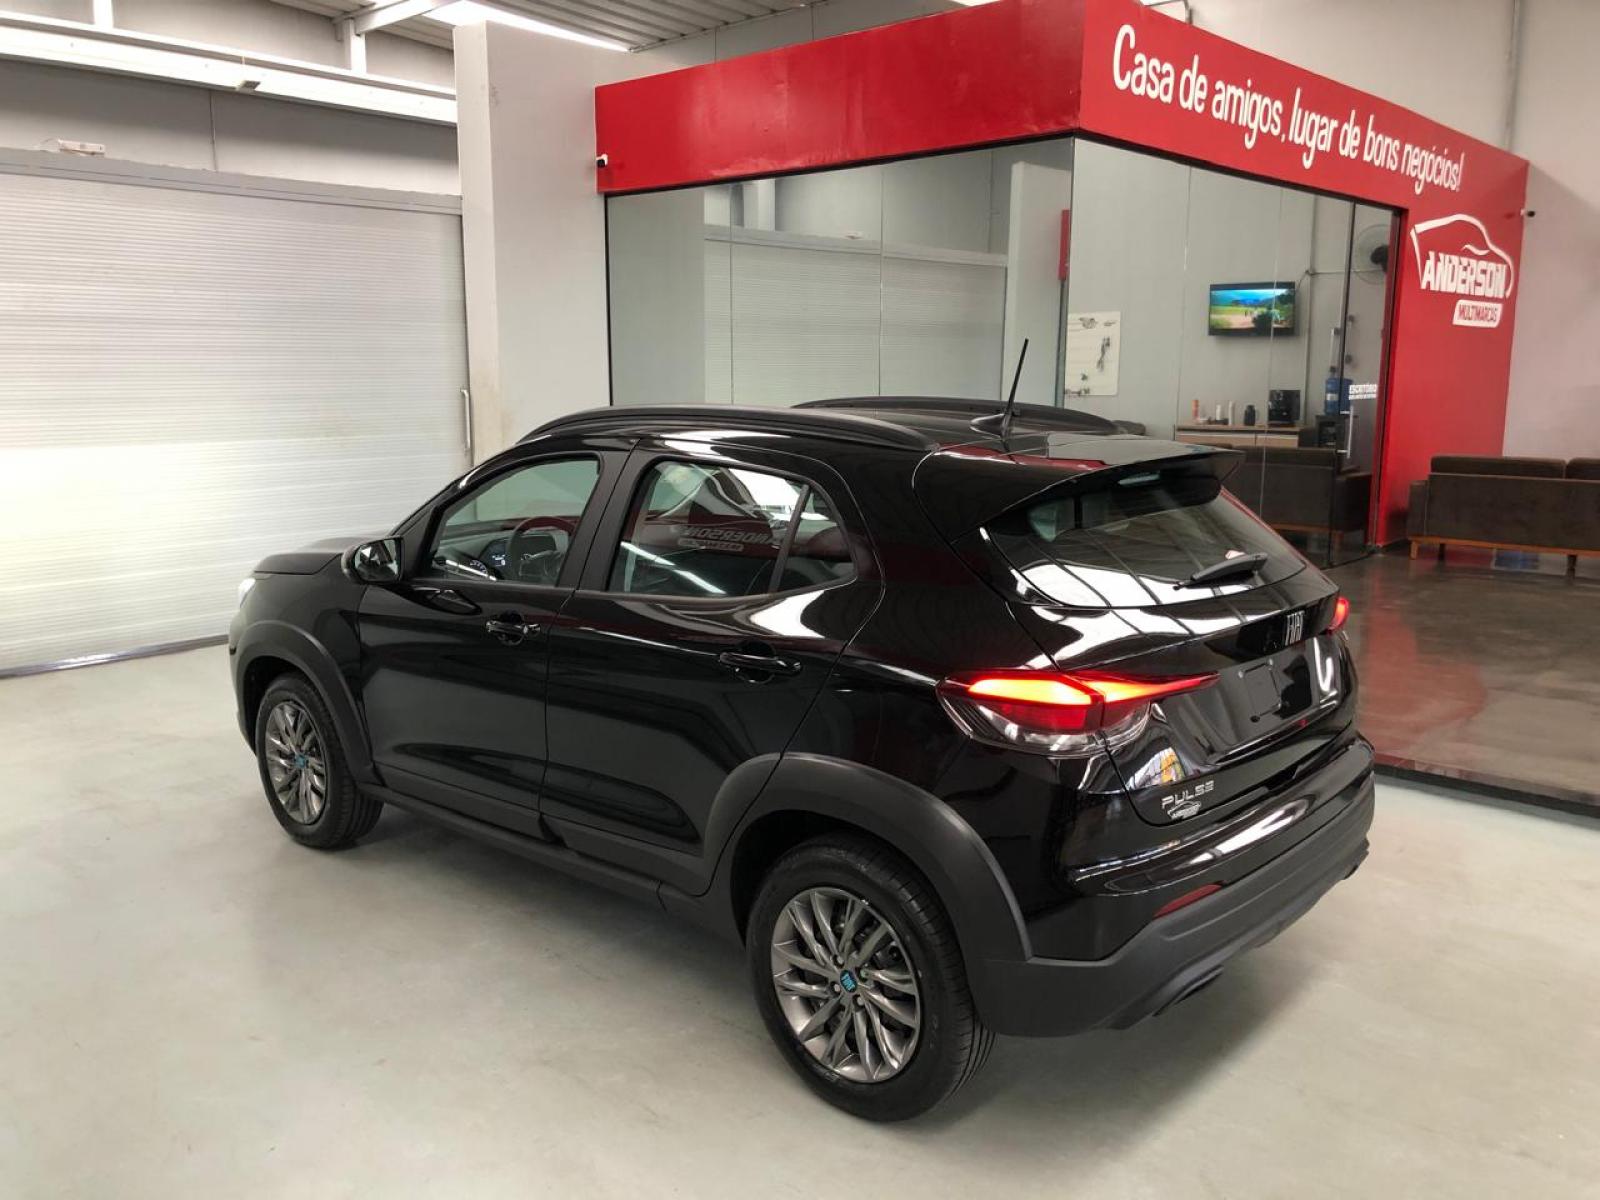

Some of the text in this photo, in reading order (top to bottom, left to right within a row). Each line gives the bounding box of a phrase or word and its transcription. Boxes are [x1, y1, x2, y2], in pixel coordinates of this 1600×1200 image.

[1113, 24, 1465, 195] Casa de amigos, lugar de bons negócios!
[1420, 251, 1507, 299] ANDERSON
[1457, 303, 1499, 322] MULTIMARCAS
[1285, 610, 1305, 646] FIAT
[1161, 780, 1214, 809] PULSE
